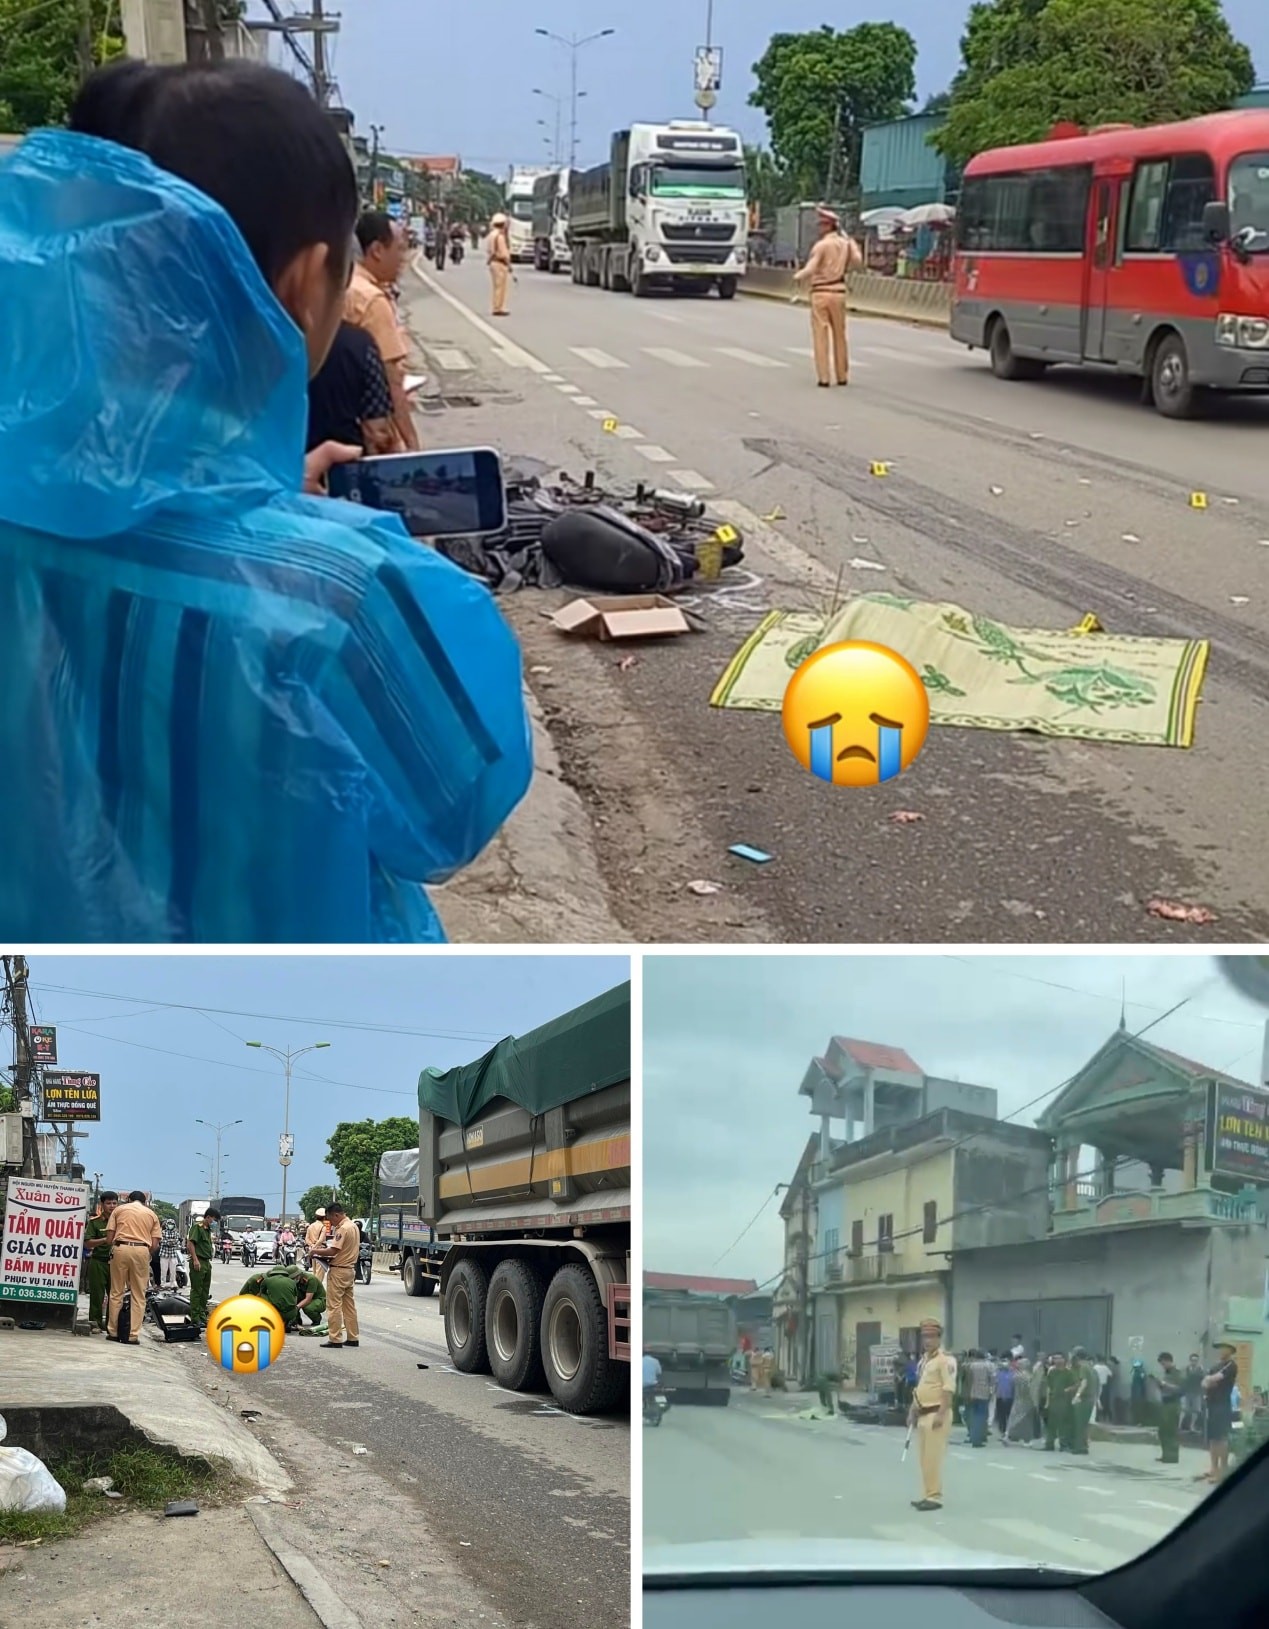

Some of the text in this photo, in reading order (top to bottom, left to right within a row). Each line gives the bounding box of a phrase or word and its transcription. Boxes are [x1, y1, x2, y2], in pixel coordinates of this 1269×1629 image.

[45, 1086, 98, 1101] LỢN TÊN LỬA
[15, 1188, 81, 1206] Xuân Sơn
[8, 1209, 84, 1240] TẨM QUẤT
[6, 1237, 79, 1260] GIÁC HƠI
[4, 1256, 78, 1279] BẤM HUYỆT
[4, 1275, 75, 1288] PHỤC VỤ TẠI NHÀ
[18, 1288, 75, 1302] 036.3398.661
